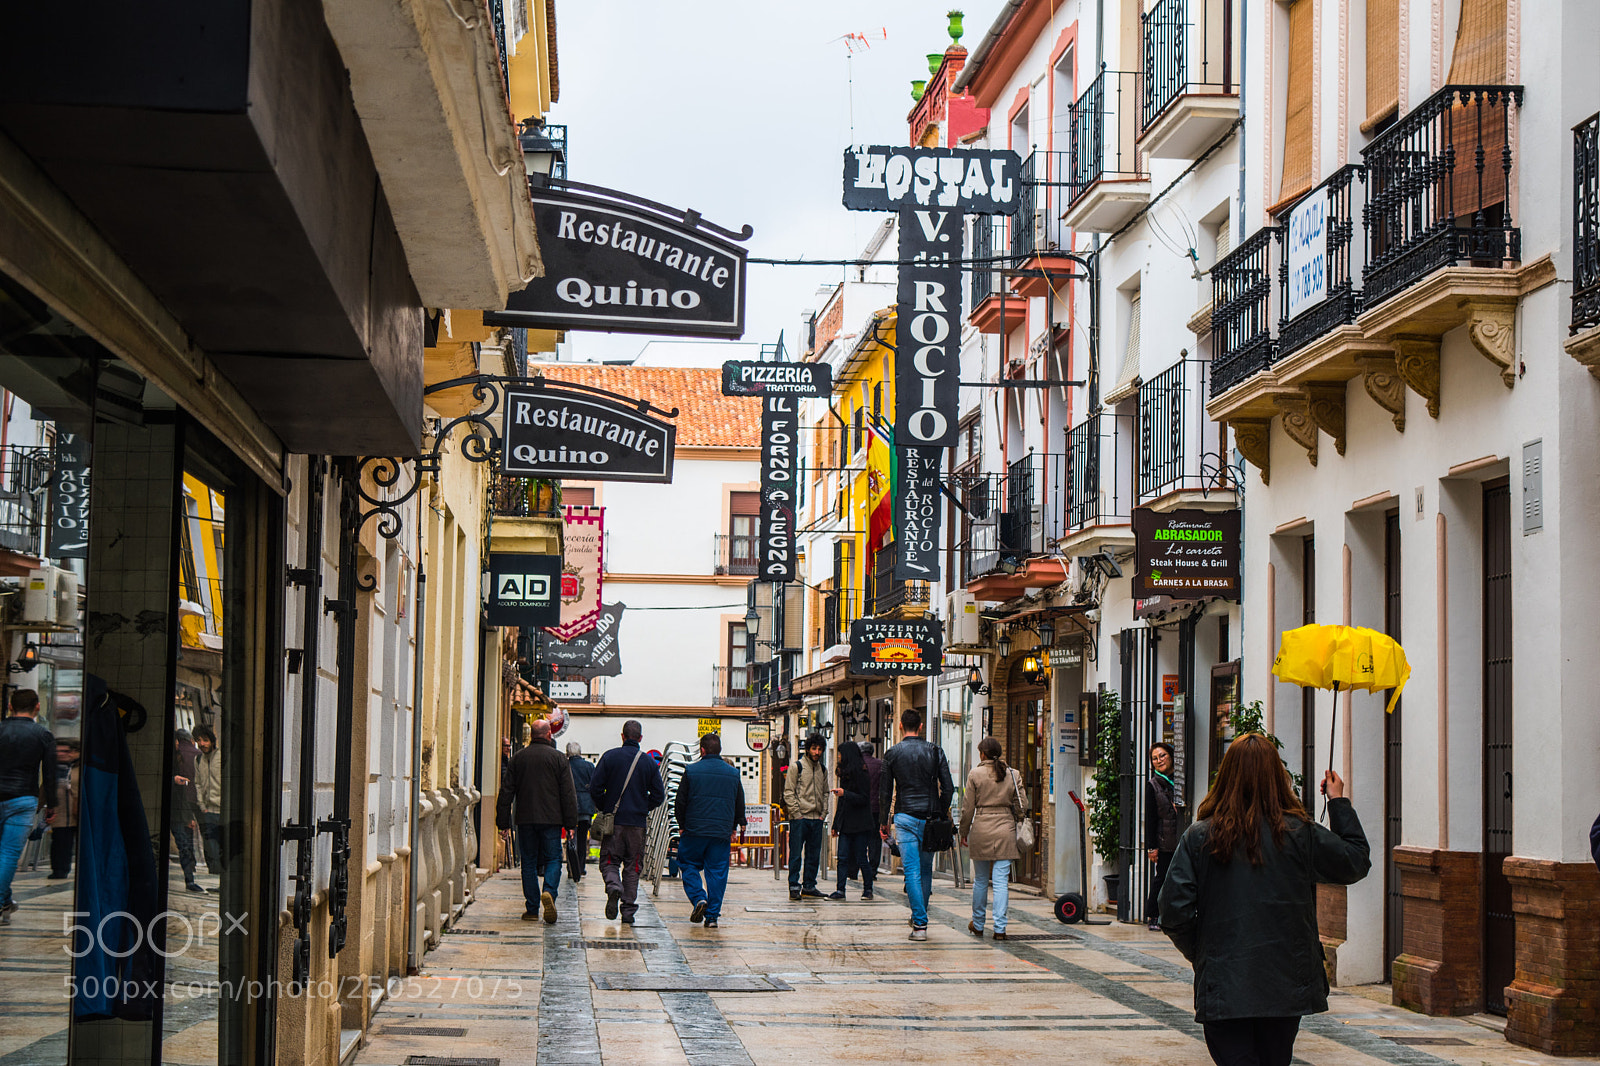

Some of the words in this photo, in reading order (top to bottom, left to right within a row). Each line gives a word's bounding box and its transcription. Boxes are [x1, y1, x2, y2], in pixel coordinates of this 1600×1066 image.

[854, 152, 1013, 207] HOSTAL
[914, 210, 950, 242] V.
[557, 211, 729, 288] Restaurante
[556, 277, 700, 309] Quino
[908, 280, 950, 442] ROCIO
[741, 366, 813, 383] PIZZERIA
[765, 384, 817, 392] TRATTORIA
[769, 396, 792, 412] IL
[515, 401, 659, 457] Restaurante
[513, 444, 609, 465] Quino
[768, 420, 791, 481] FORNO
[924, 458, 936, 470] V.
[921, 477, 934, 487] del
[904, 448, 920, 561] RESTAURANTE
[920, 494, 934, 551] ROCIO
[767, 509, 788, 574] LEGNA
[1154, 529, 1223, 541] ABRASADOR
[1186, 546, 1223, 555] carreta
[1150, 558, 1173, 567] Steak
[1175, 559, 1199, 567] House
[1211, 559, 1228, 567] Grill
[500, 578, 547, 595] AD
[1153, 579, 1183, 587] CARNES
[1185, 579, 1190, 587] A
[1192, 579, 1202, 587] LA
[1203, 579, 1228, 587] BRASA
[865, 624, 929, 633] PIZZERIA
[860, 631, 935, 645] ITALIANA
[597, 650, 616, 667] PIEL
[862, 662, 898, 670] NONNO
[900, 662, 932, 671] PEPPE
